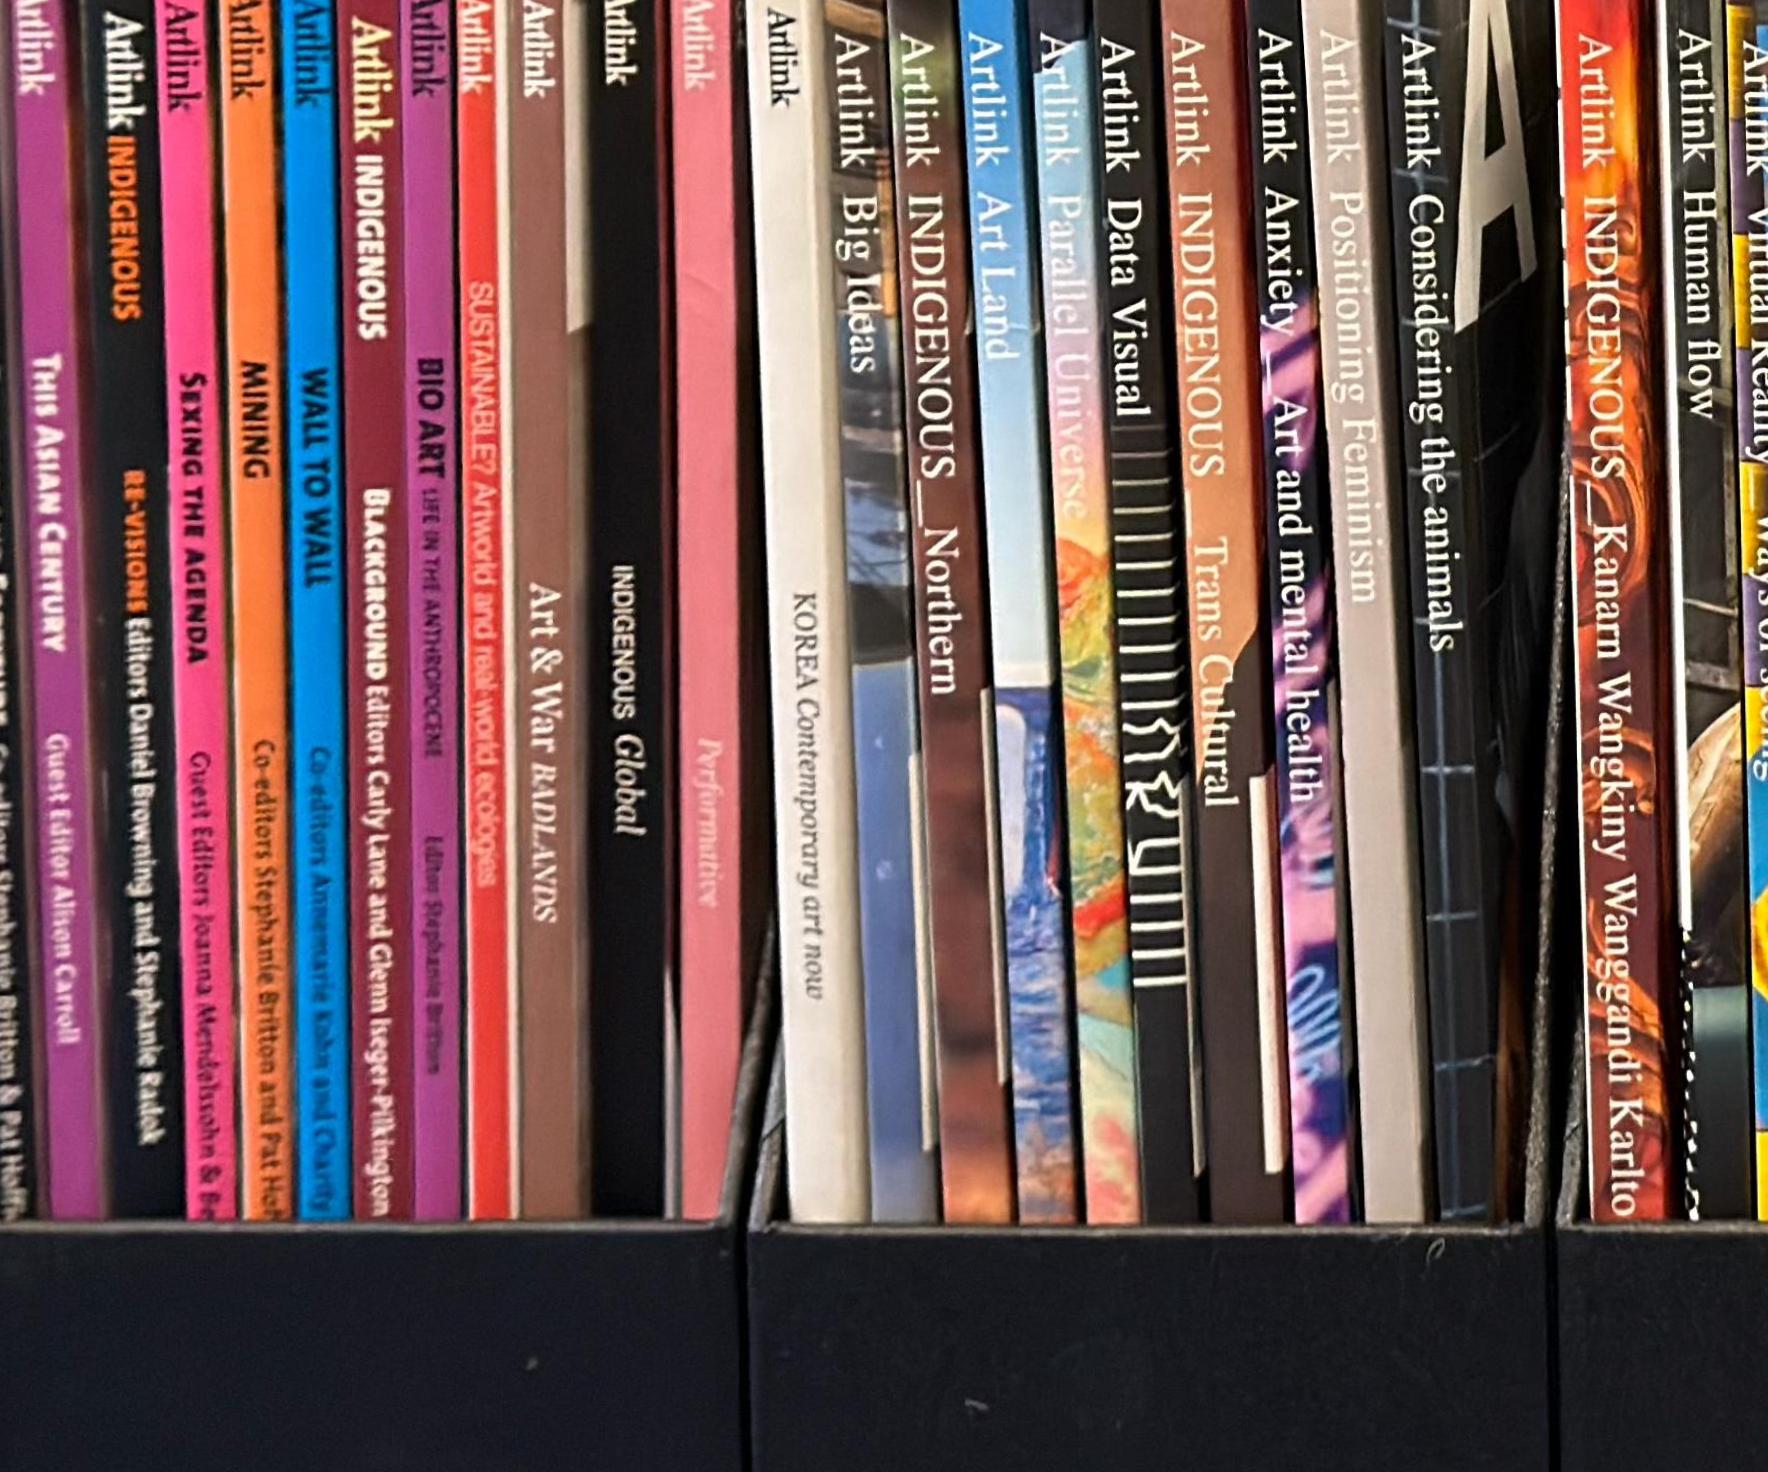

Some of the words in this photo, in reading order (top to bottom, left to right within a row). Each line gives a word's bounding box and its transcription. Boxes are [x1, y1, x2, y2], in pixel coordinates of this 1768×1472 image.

[104, 12, 145, 130] Artlink
[164, 0, 200, 112] Artlink
[352, 16, 393, 142] Artlink
[766, 7, 799, 107] Artlink
[833, 34, 868, 168] Artlink
[899, 34, 936, 167] Artlink
[968, 31, 1006, 165] Artlink
[1039, 32, 1079, 165] Artlink
[1100, 36, 1140, 172] Artlink
[1257, 28, 1297, 163] Artlink
[1319, 29, 1357, 163] Artlink
[1400, 34, 1441, 169] Artlink
[1578, 34, 1617, 169] Artlink
[1677, 29, 1716, 163] Artlink
[106, 136, 142, 320] INDIGENOUS
[355, 155, 388, 340] INDIGENOUS
[837, 193, 878, 261] Big
[976, 191, 1011, 251] Art
[1048, 194, 1089, 335] Parallel
[1107, 197, 1145, 285] Data
[1261, 186, 1302, 335] Anxiety
[1682, 189, 1720, 324] Human
[846, 274, 883, 373] Ideas
[982, 266, 1019, 359] Land
[1328, 191, 1372, 404] Positioning
[1407, 193, 1453, 422] Considering
[302, 367, 328, 450] WALL
[419, 357, 444, 411] BIO
[469, 282, 495, 474] SUSTAINABLE?
[1111, 298, 1151, 417] Visual
[1687, 339, 1721, 419] flow
[240, 361, 270, 479] MINING
[304, 457, 329, 499] TO
[419, 419, 445, 479] ART
[1055, 352, 1093, 519] Universe
[1170, 31, 1208, 166] Artlink
[1197, 654, 1239, 808] Cultural
[1420, 437, 1454, 493] the
[303, 511, 332, 587] WALL
[472, 482, 498, 585] Artworld
[1277, 470, 1313, 536] and
[1342, 418, 1381, 602] Feminism
[473, 592, 499, 639] and
[529, 583, 561, 638] Art
[1280, 550, 1319, 674] mental
[1423, 507, 1464, 652] animals
[125, 617, 151, 698] Editors
[611, 565, 636, 718] INDIGENOUS
[792, 592, 818, 690] KOREA
[130, 704, 155, 777] Daniel
[474, 646, 501, 767] real-world
[532, 681, 562, 752] War
[1286, 689, 1323, 803] health
[613, 734, 646, 835] Global
[692, 739, 723, 908] Performative
[793, 697, 825, 888] Contemporary
[1590, 673, 1634, 861] Wangkiny
[125, 783, 155, 896] Browning
[470, 772, 501, 887] ecologies
[530, 762, 558, 923] BADLANDS
[134, 901, 157, 947] and
[801, 895, 824, 936] art
[804, 944, 826, 1000] now
[132, 952, 159, 1067] Stephanie
[1595, 873, 1640, 1083] Wanggandi
[138, 1073, 164, 1145] Radok
[1608, 1098, 1647, 1216] Karlto
